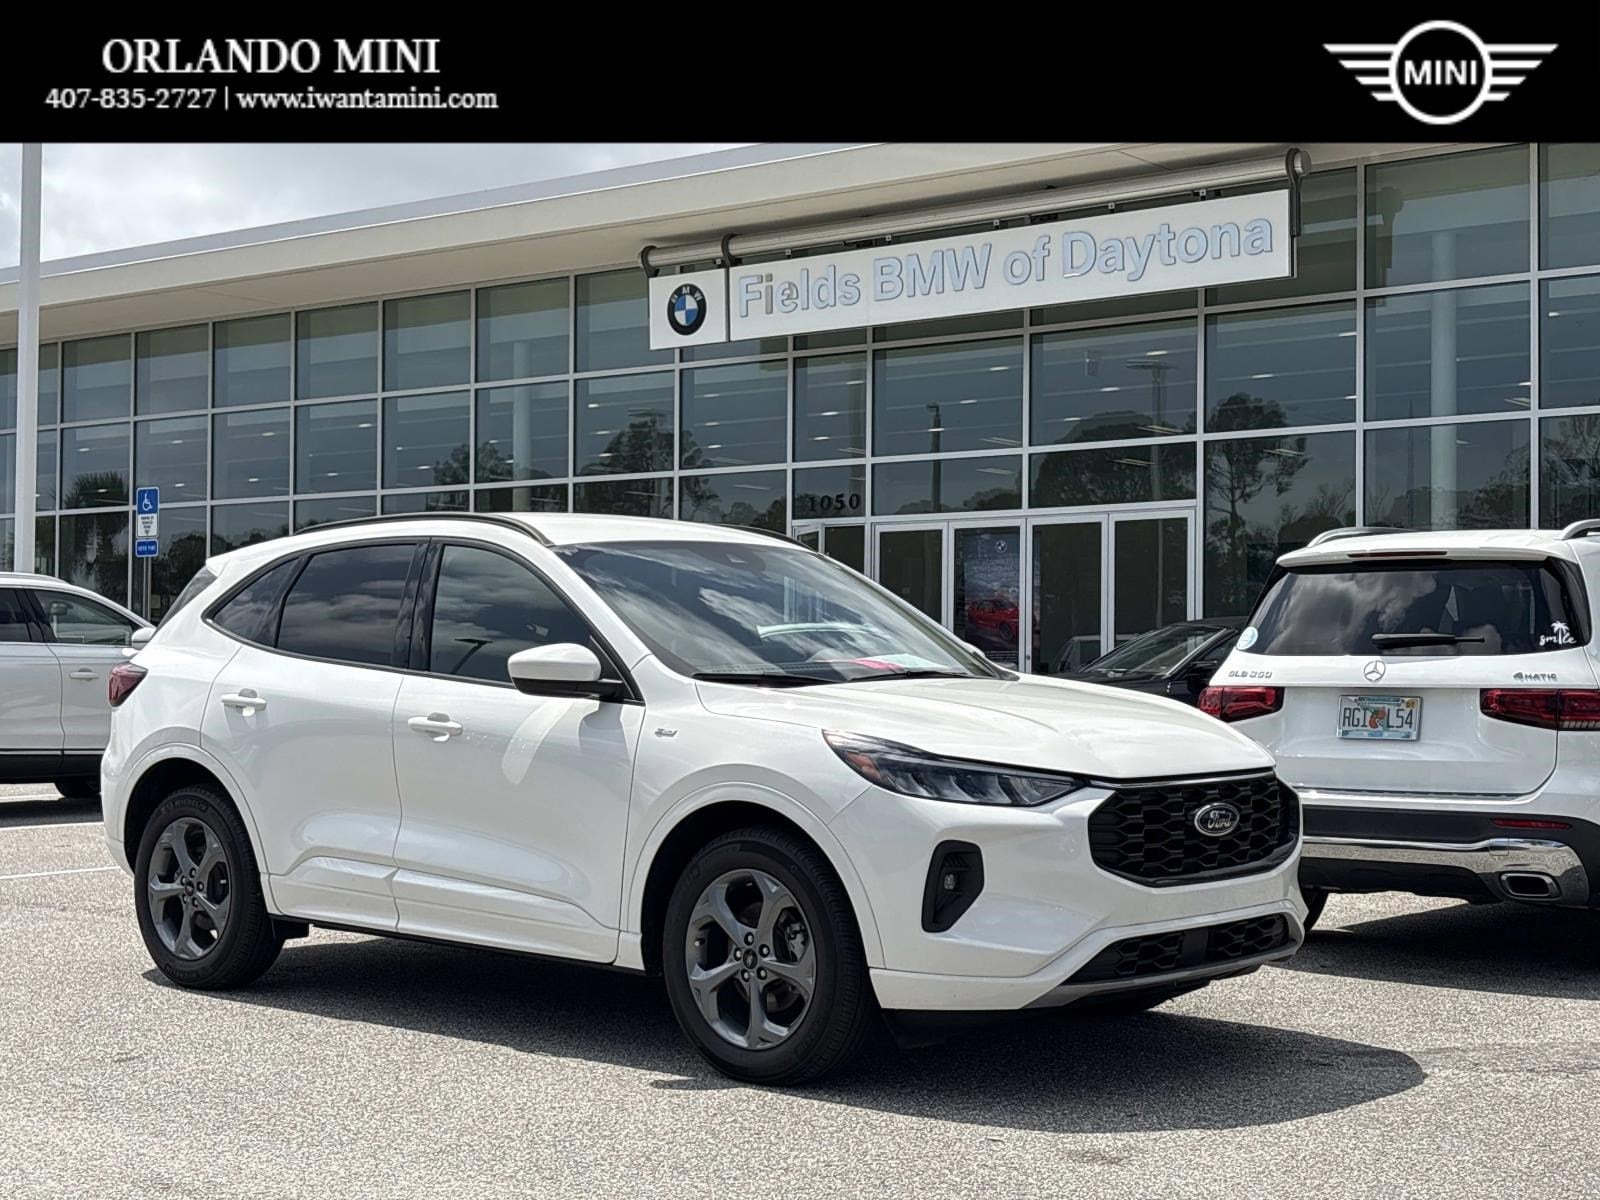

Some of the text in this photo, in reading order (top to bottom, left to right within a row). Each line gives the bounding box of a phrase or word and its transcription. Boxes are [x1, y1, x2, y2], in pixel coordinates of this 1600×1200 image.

[739, 218, 1274, 318] Fields BMW of Daytona
[670, 286, 703, 304] BMW
[807, 492, 861, 513] 1050
[1342, 706, 1413, 729] RGI L54
[1207, 810, 1232, 829] Ford
